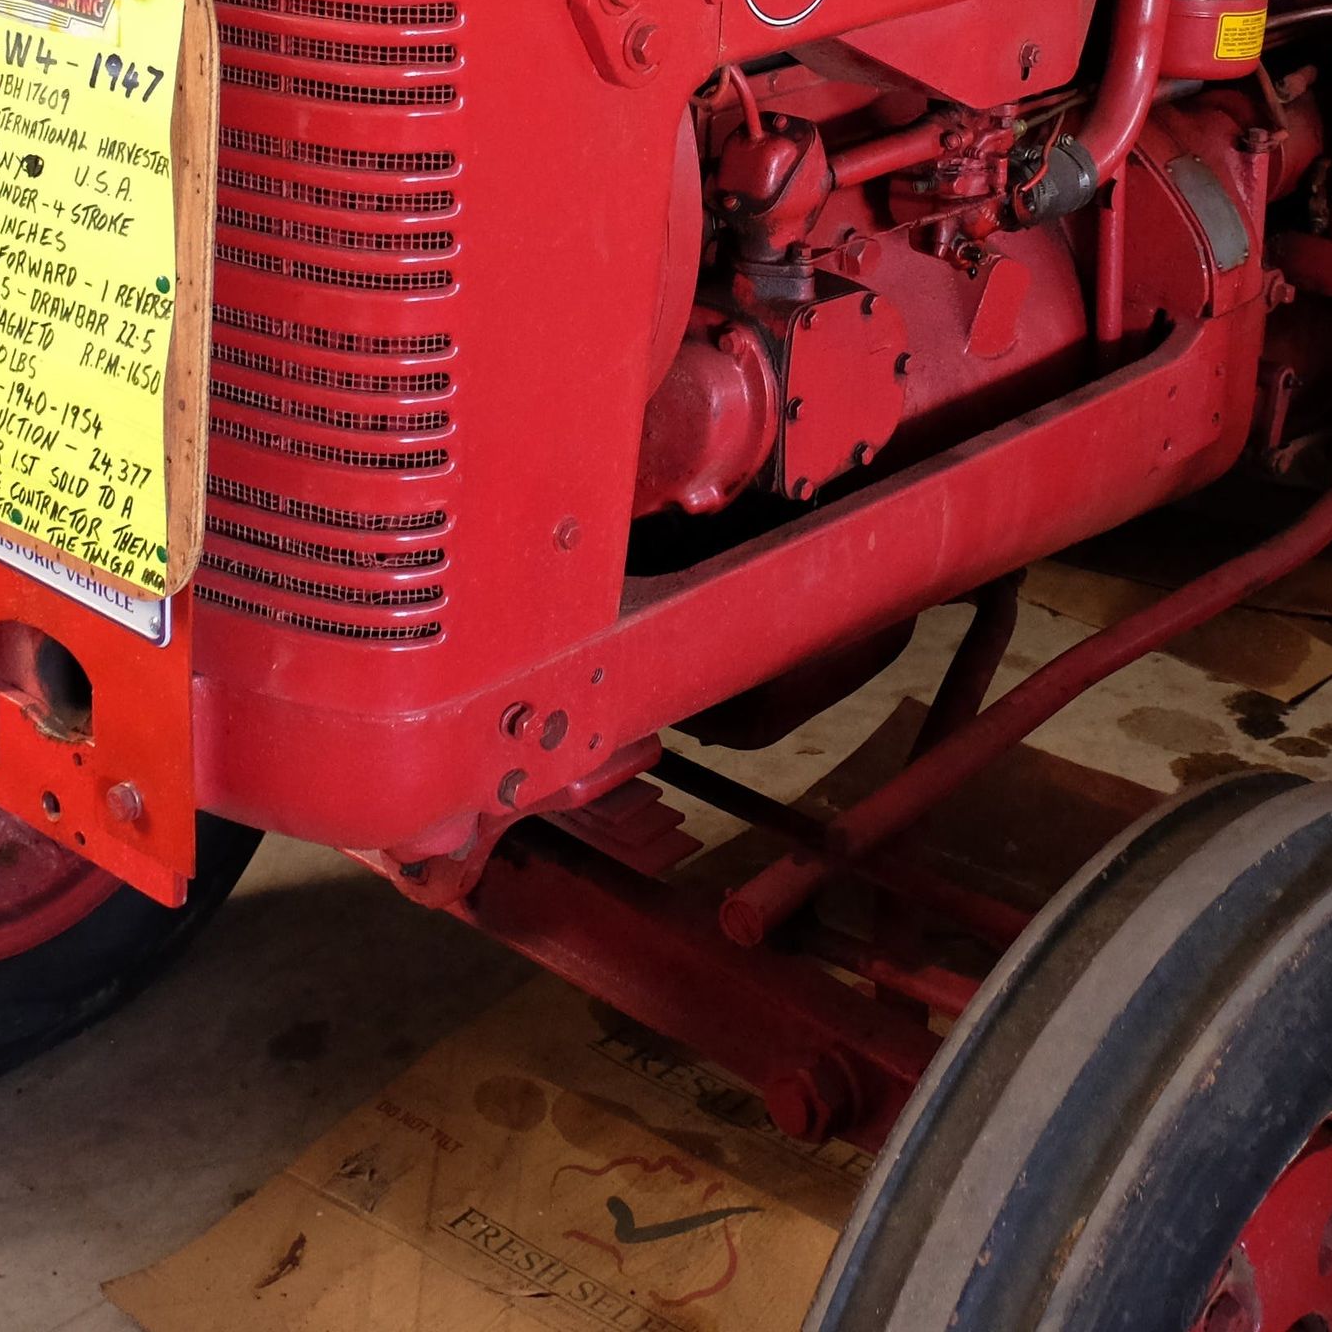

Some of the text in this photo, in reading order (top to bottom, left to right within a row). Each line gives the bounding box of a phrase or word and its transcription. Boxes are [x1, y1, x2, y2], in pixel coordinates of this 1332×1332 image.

[89, 52, 165, 103] 1947
[97, 136, 169, 179] HARVESTER
[0, 214, 67, 252] INCHES
[70, 203, 135, 237] STROKE
[30, 288, 109, 337] DRAWBAR
[114, 283, 175, 320] REVERSE
[88, 447, 153, 489] 24,377
[49, 466, 89, 499] SOLD
[98, 485, 116, 510] TO
[120, 495, 134, 520] A
[9, 481, 103, 541] CONTRACTOR
[112, 523, 157, 562] THEN
[46, 526, 80, 552] THE
[66, 567, 135, 613] VEHICLE
[448, 1206, 570, 1287] FRESH
